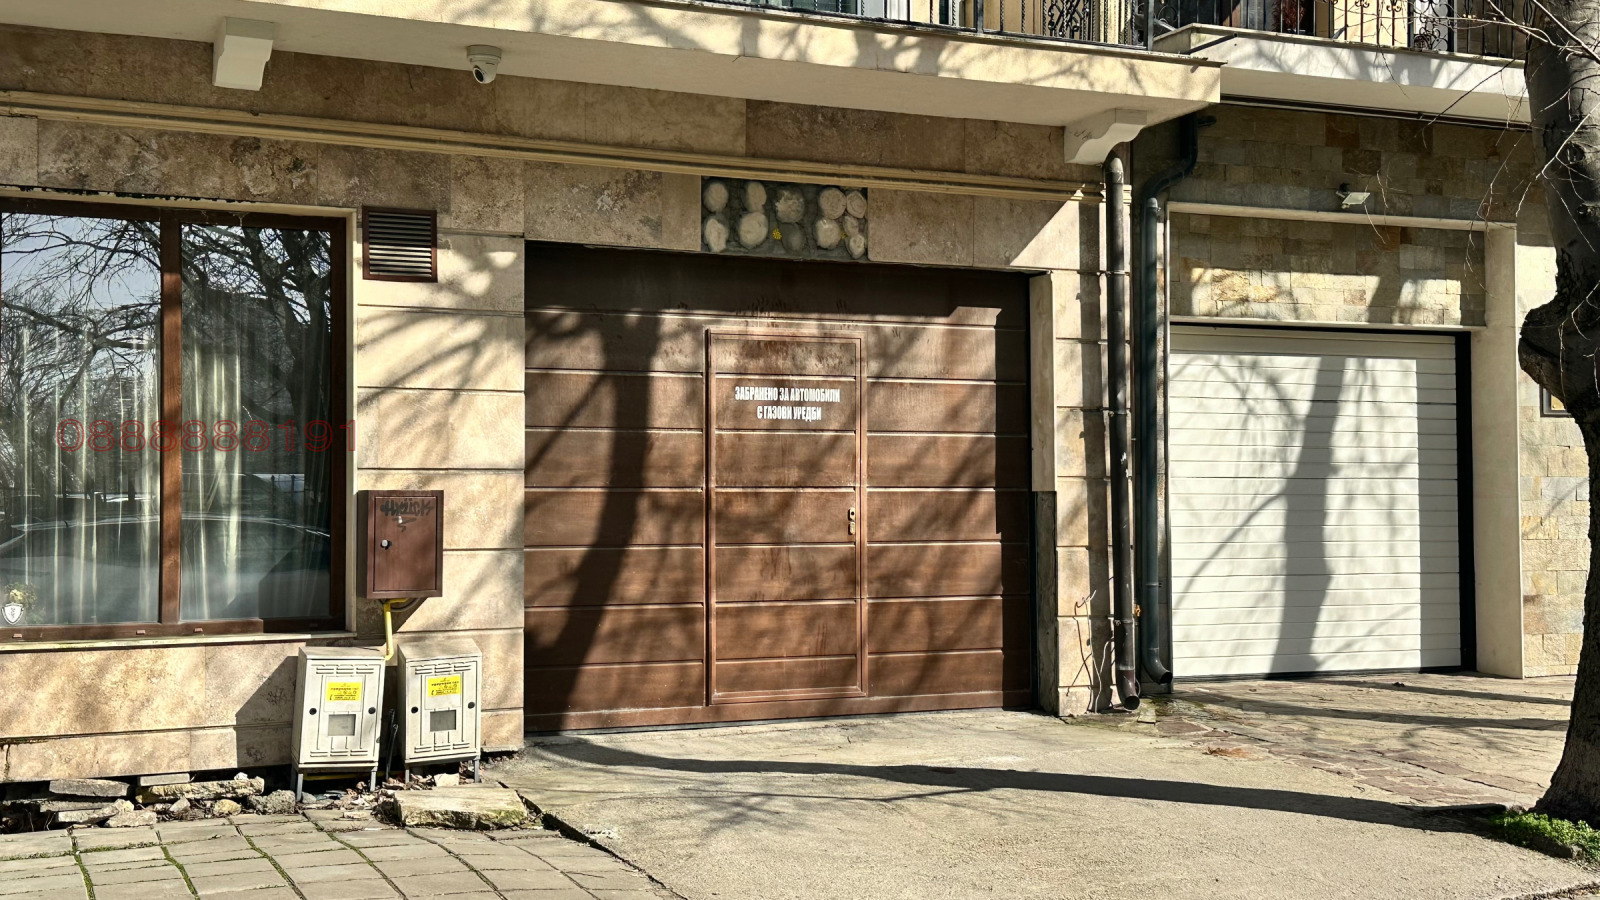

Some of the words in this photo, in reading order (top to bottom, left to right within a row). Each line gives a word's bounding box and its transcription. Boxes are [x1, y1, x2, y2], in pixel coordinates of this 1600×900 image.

[735, 386, 778, 400] ЗАБРАНЕНО
[779, 388, 789, 401] ЗА
[790, 388, 840, 402] АВТОМОБИЛИ
[757, 405, 763, 419] С
[764, 406, 792, 420] ГАЗОВИ
[793, 406, 821, 422] УРЕДБИ
